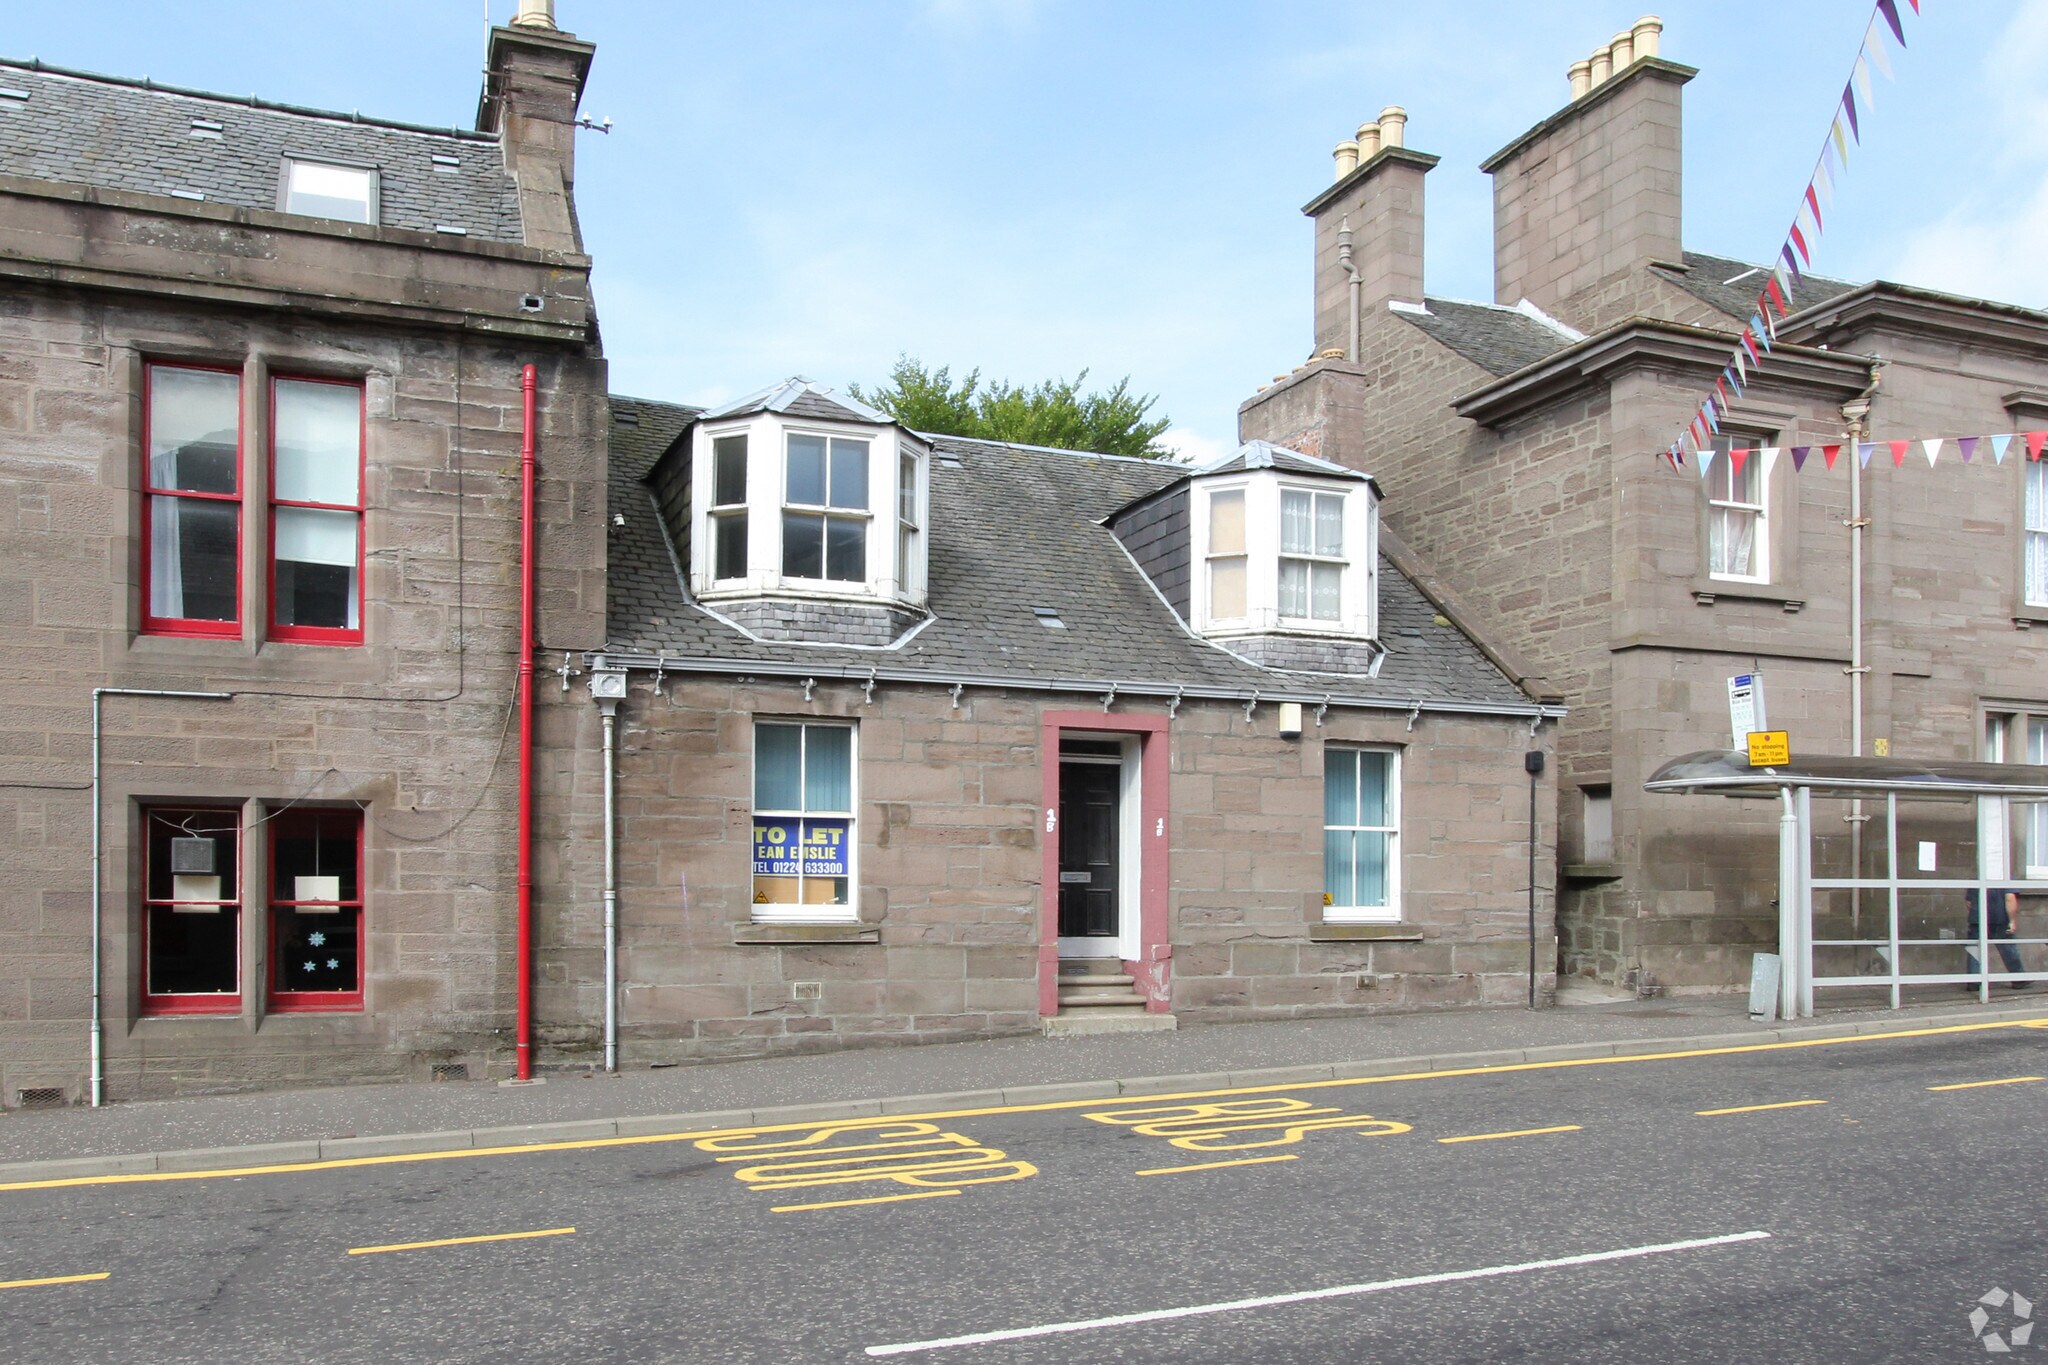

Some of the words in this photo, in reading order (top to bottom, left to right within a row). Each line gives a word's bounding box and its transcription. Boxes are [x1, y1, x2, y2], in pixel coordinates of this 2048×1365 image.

[753, 826, 787, 844] TO
[753, 861, 770, 873] TEL
[805, 861, 843, 874] 633300
[1080, 1097, 1414, 1152] BUS
[693, 1121, 1040, 1191] STOP
